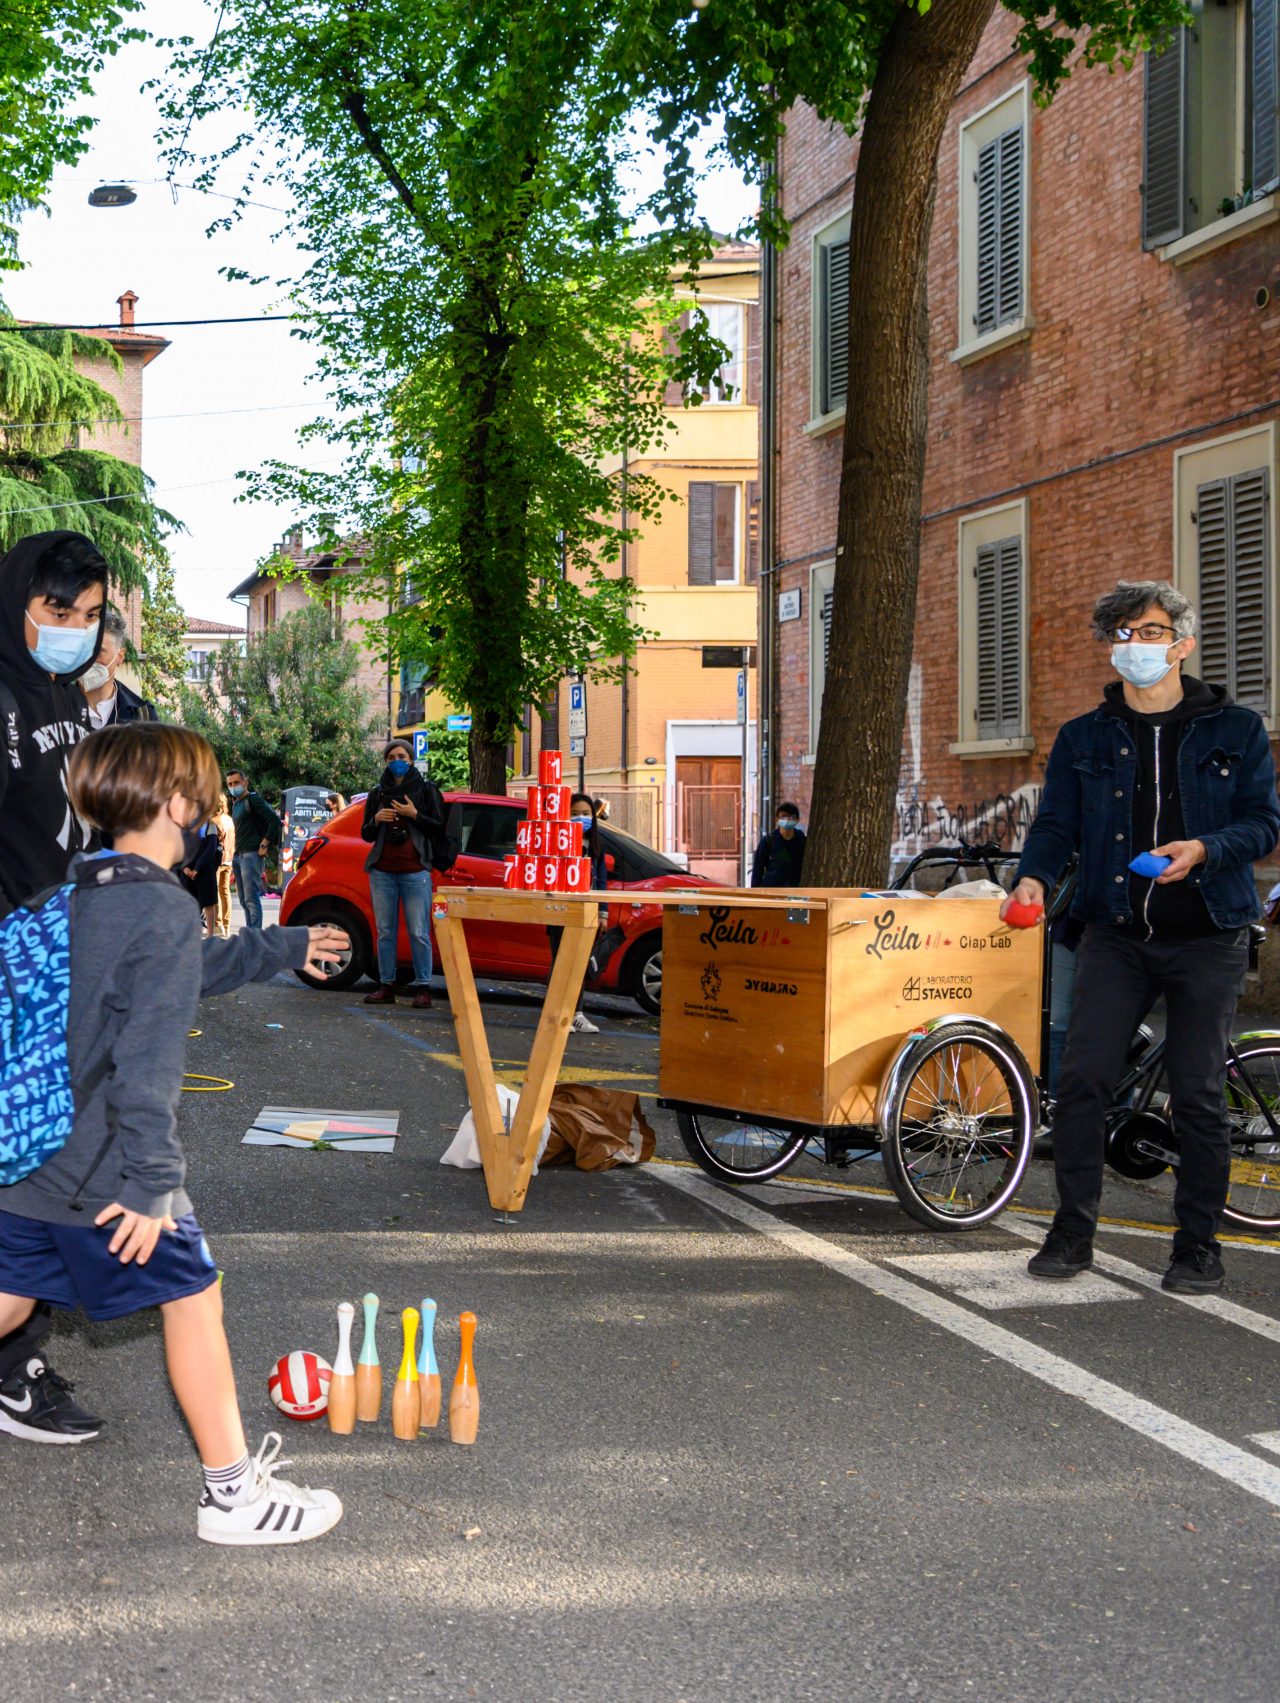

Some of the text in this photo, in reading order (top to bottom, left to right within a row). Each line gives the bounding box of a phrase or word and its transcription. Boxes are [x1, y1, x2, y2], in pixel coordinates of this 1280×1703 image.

[573, 689, 580, 706] P
[417, 735, 425, 758] P
[550, 758, 561, 779] 1
[546, 793, 560, 814] 3
[516, 827, 528, 849] 4
[557, 829, 569, 850] 6
[503, 862, 580, 886] 7 8 9 0
[700, 905, 758, 950] Leila
[865, 909, 1011, 960] Leila Ciap Lab
[922, 975, 972, 1000] LABORATORIO STAVECO
